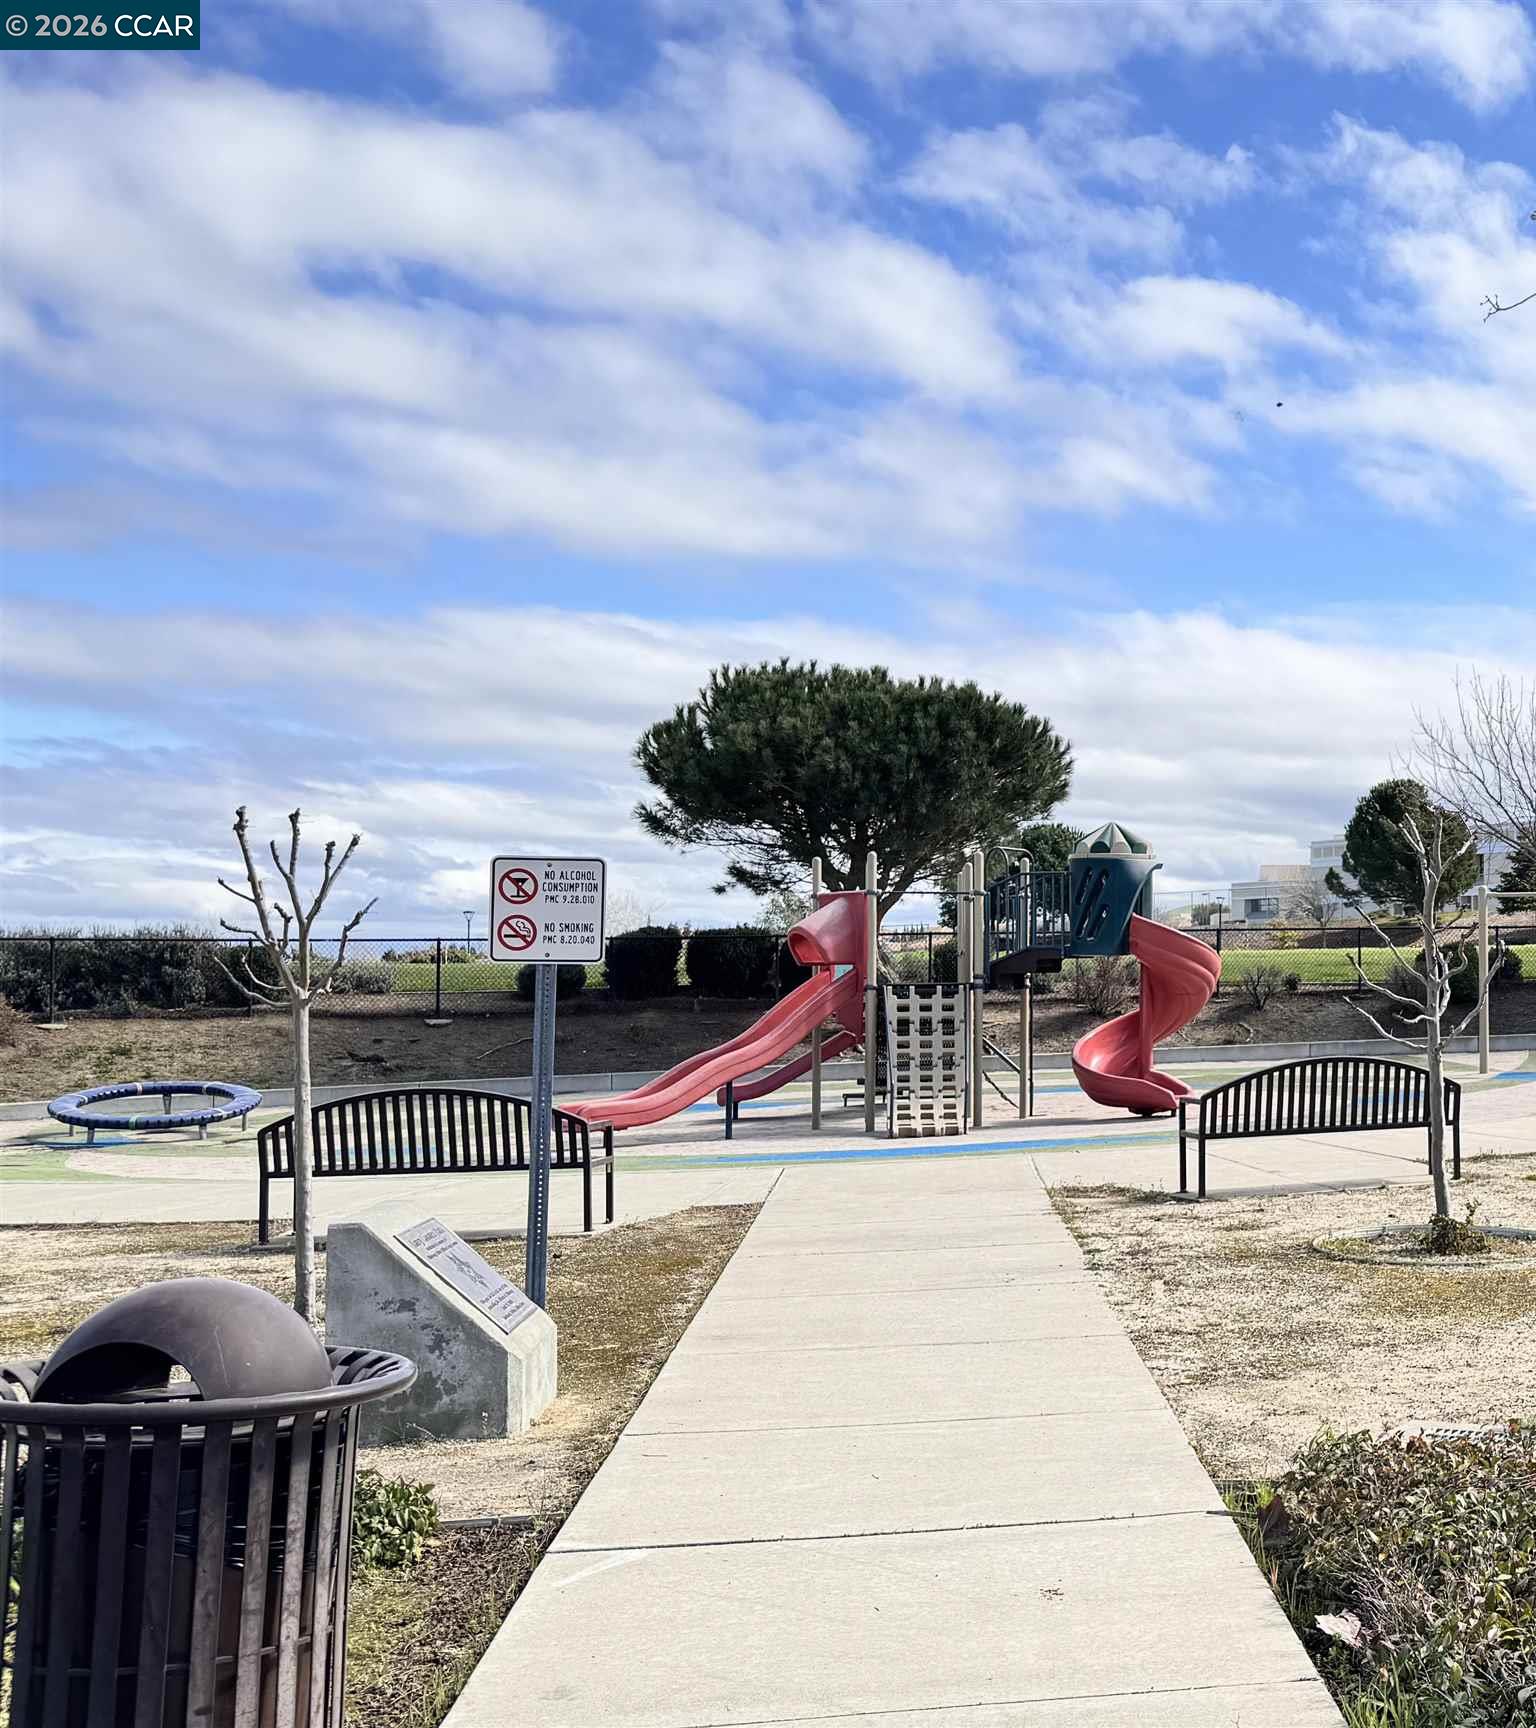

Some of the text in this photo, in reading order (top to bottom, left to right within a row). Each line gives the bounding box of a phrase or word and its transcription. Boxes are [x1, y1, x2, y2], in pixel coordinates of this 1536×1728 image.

[544, 870, 596, 881] NO ALCOHOL
[542, 882, 599, 893] CONSUMPTION
[545, 895, 559, 904] PMC
[544, 922, 595, 933] NO SMOKING
[542, 935, 595, 945] PMC 8.20.040
